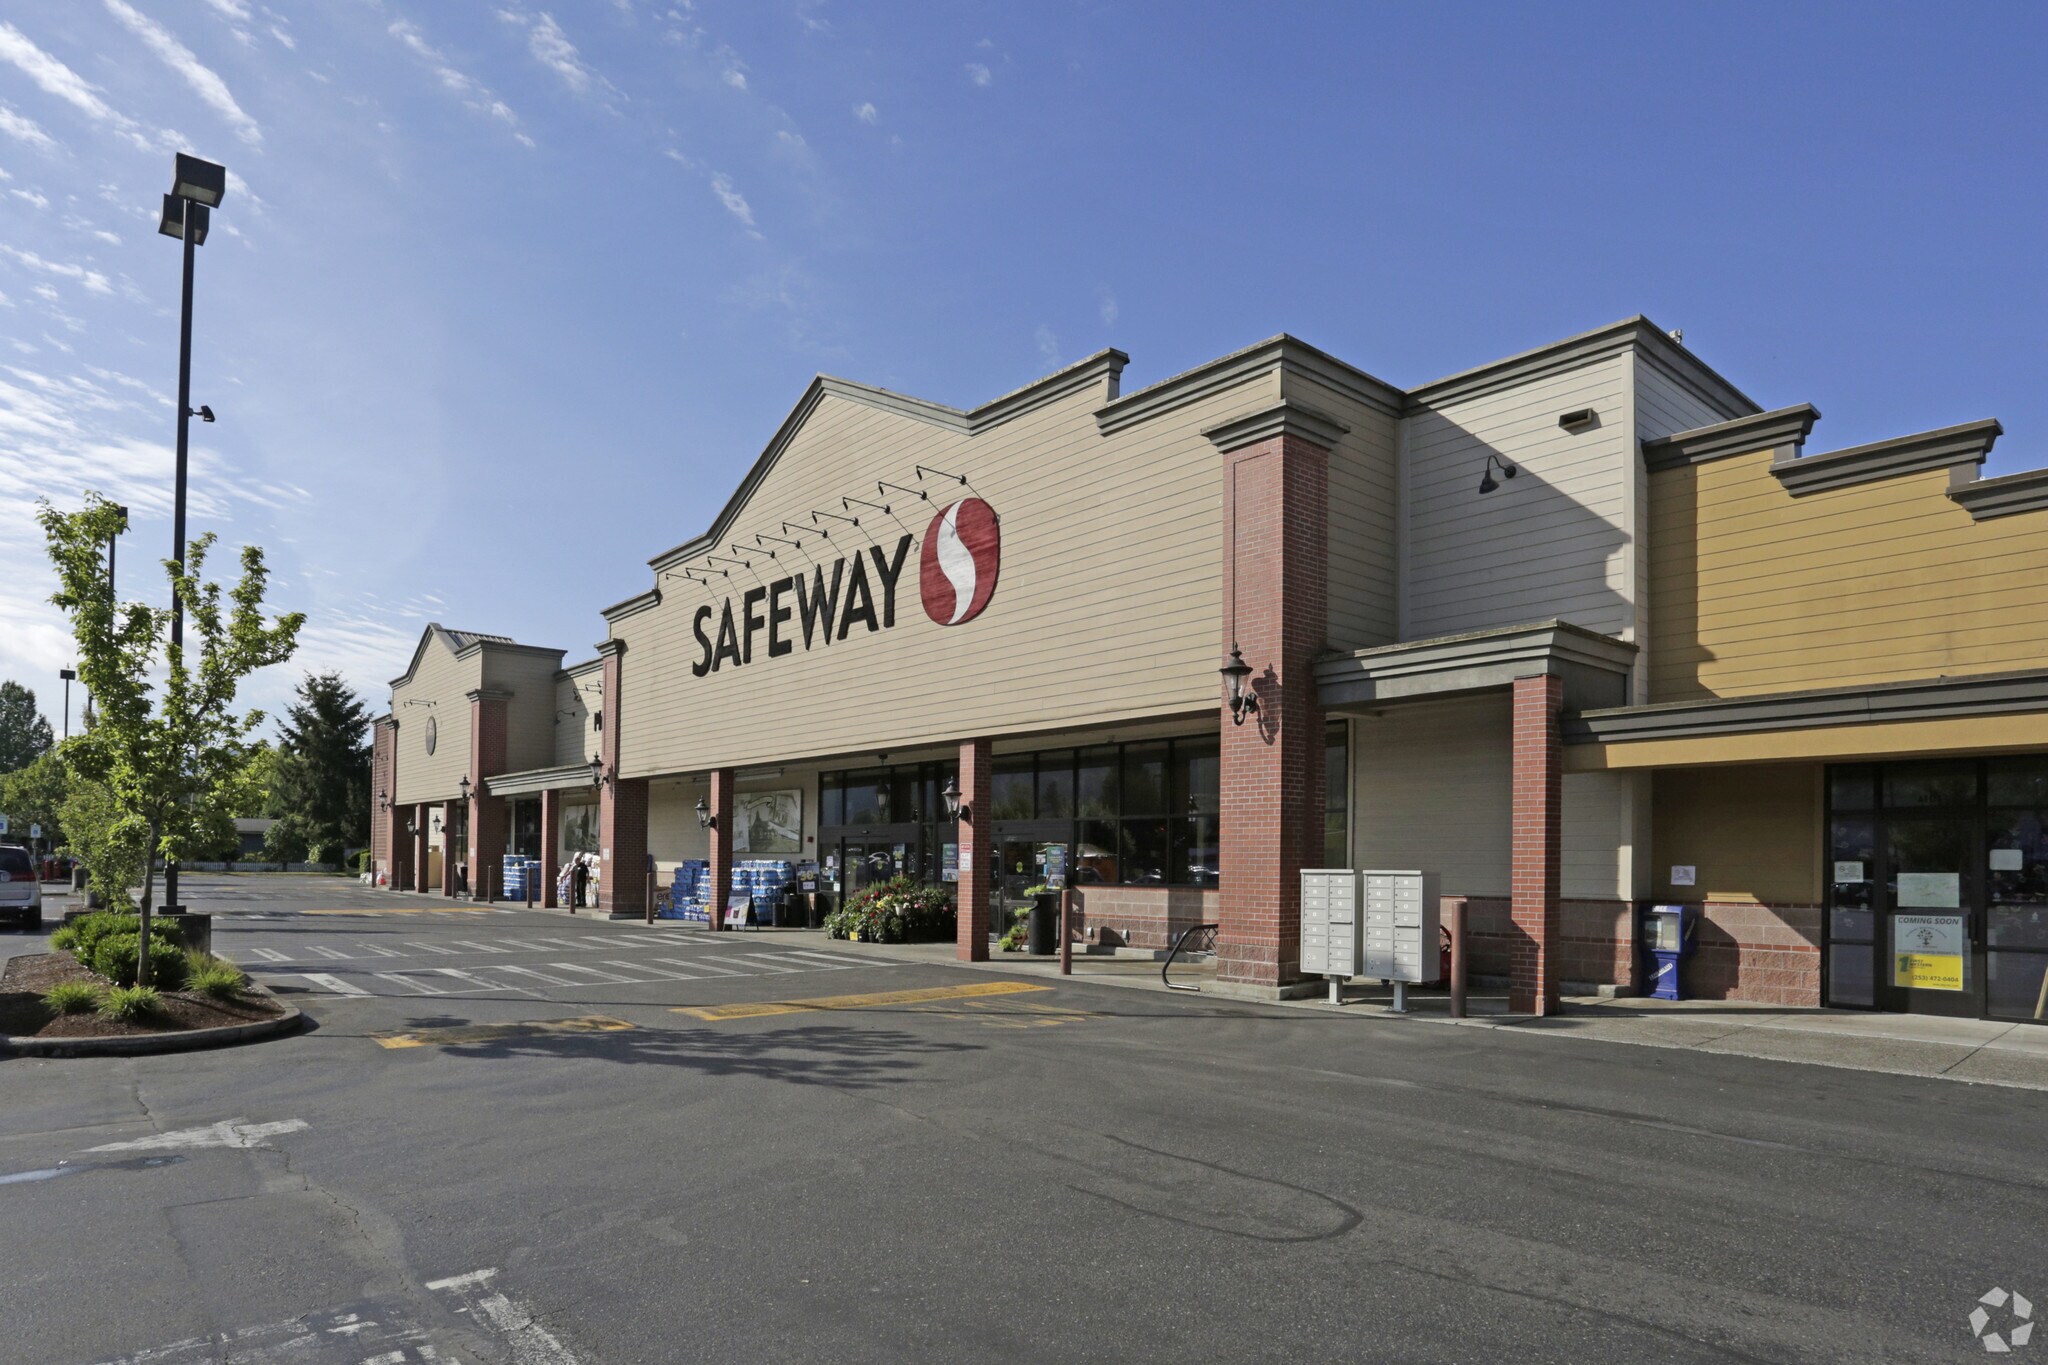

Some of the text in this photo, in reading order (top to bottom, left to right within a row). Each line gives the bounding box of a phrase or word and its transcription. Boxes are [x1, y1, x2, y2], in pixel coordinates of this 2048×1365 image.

[692, 533, 914, 678] SAFEWAY
[1898, 917, 1959, 925] COMING SOON
